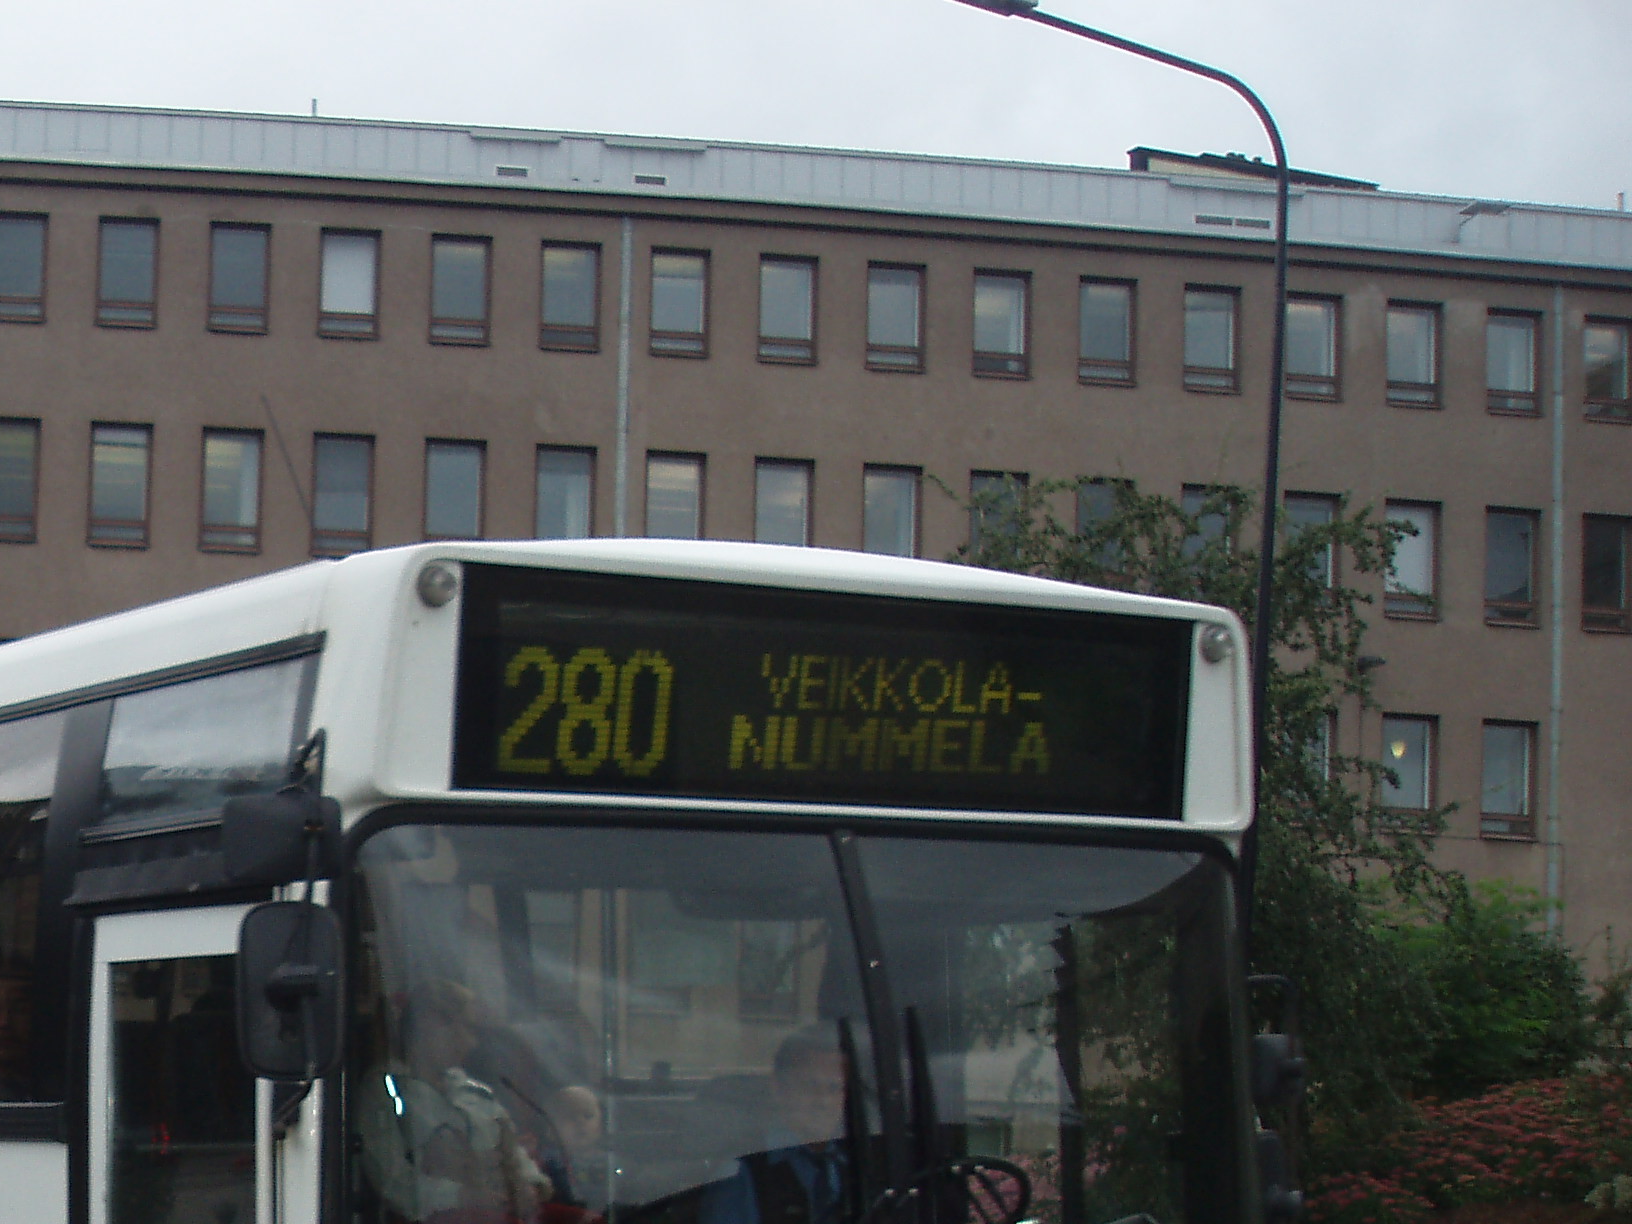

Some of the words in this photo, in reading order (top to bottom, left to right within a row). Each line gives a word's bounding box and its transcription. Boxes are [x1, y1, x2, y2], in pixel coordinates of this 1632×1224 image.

[498, 645, 675, 778] 280
[761, 652, 1043, 715] VEIKKOLA-
[728, 715, 1051, 775] NUMMELA
